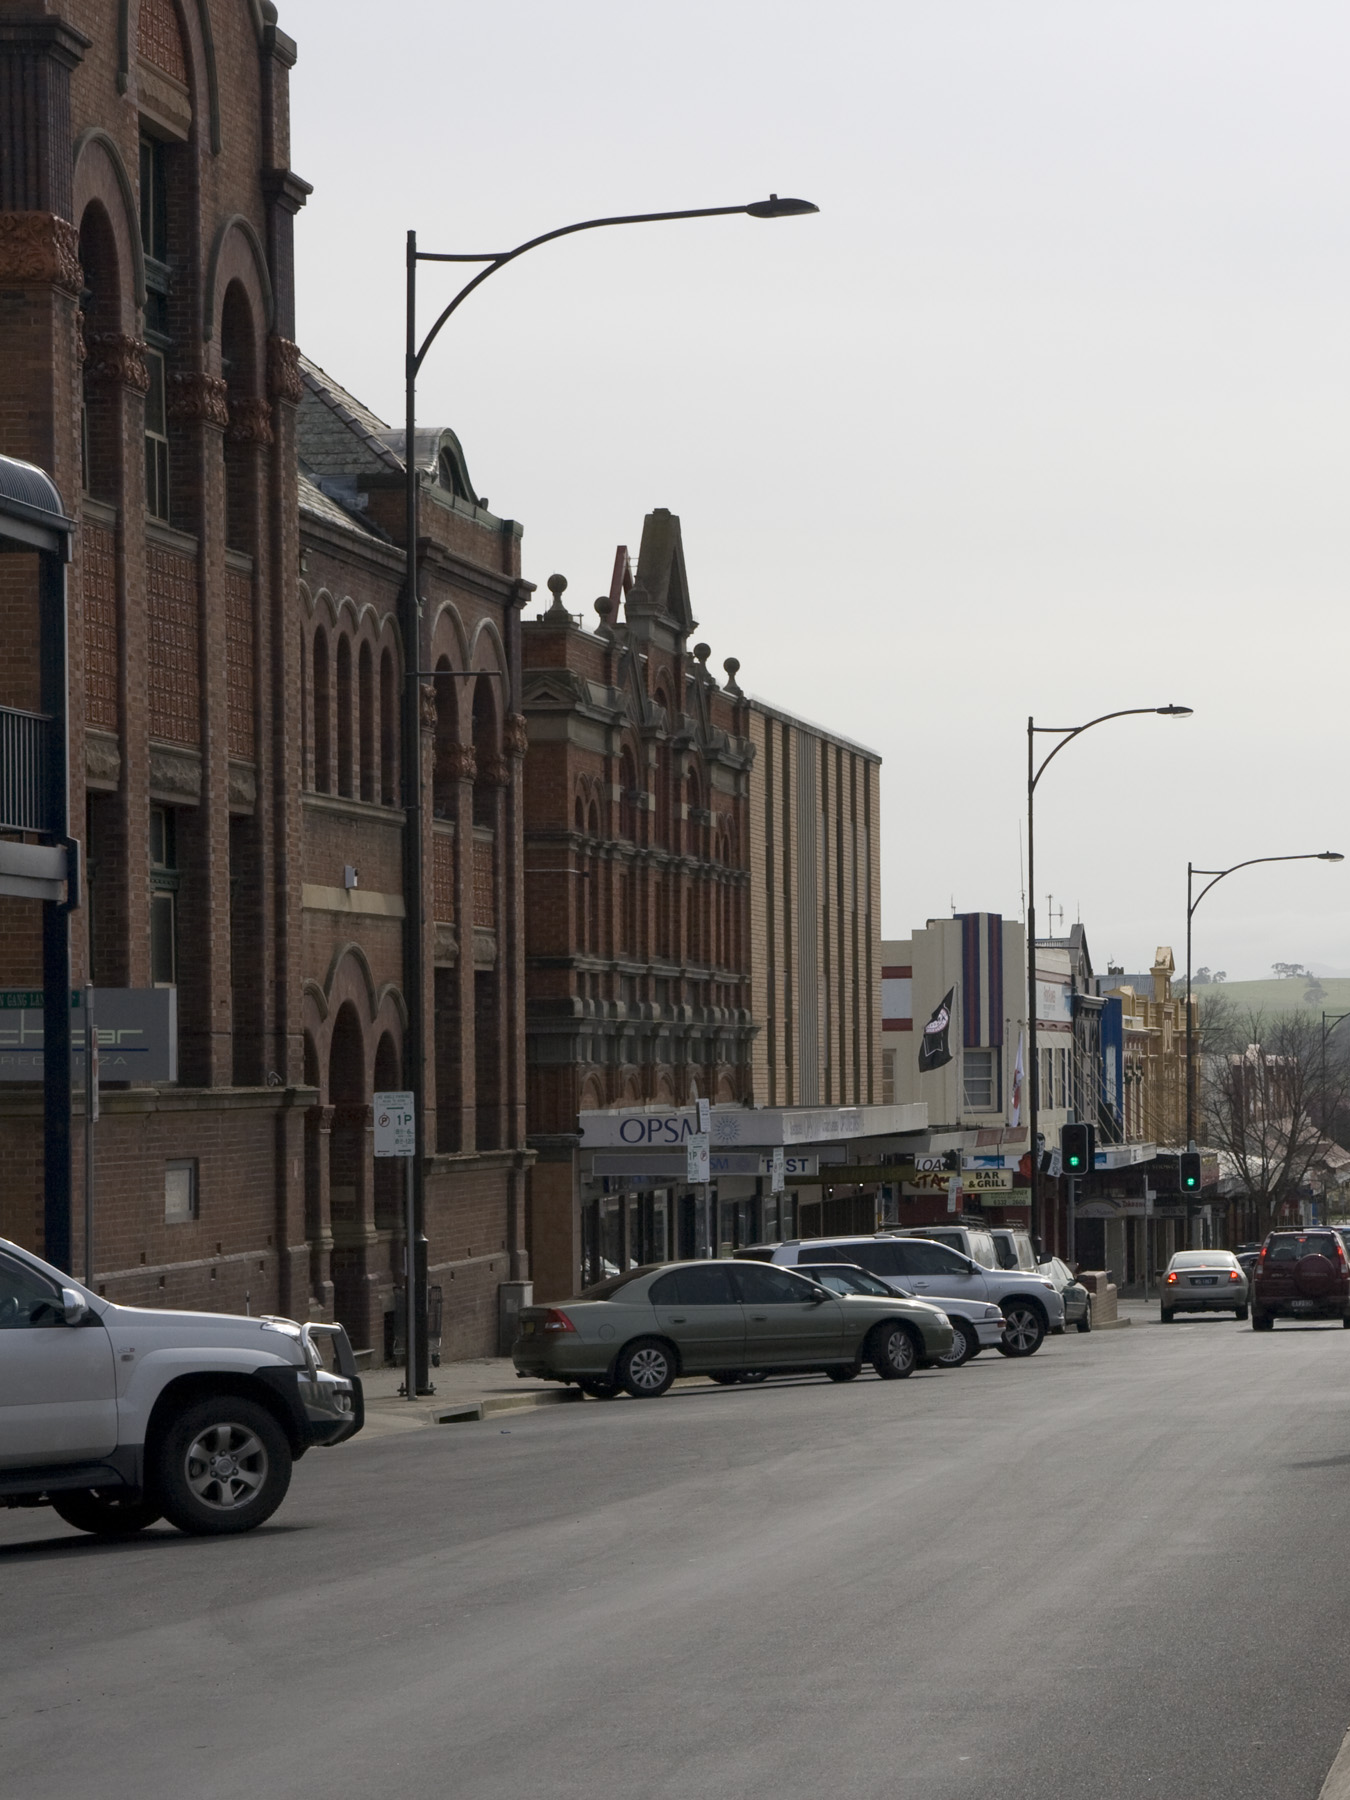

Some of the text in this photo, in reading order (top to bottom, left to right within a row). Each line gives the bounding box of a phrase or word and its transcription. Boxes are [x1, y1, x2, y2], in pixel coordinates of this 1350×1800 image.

[766, 1159, 809, 1173] PST
[916, 1159, 948, 1171] LOA
[975, 1171, 1000, 1180] BAR
[968, 1180, 1007, 1188] & GRILL
